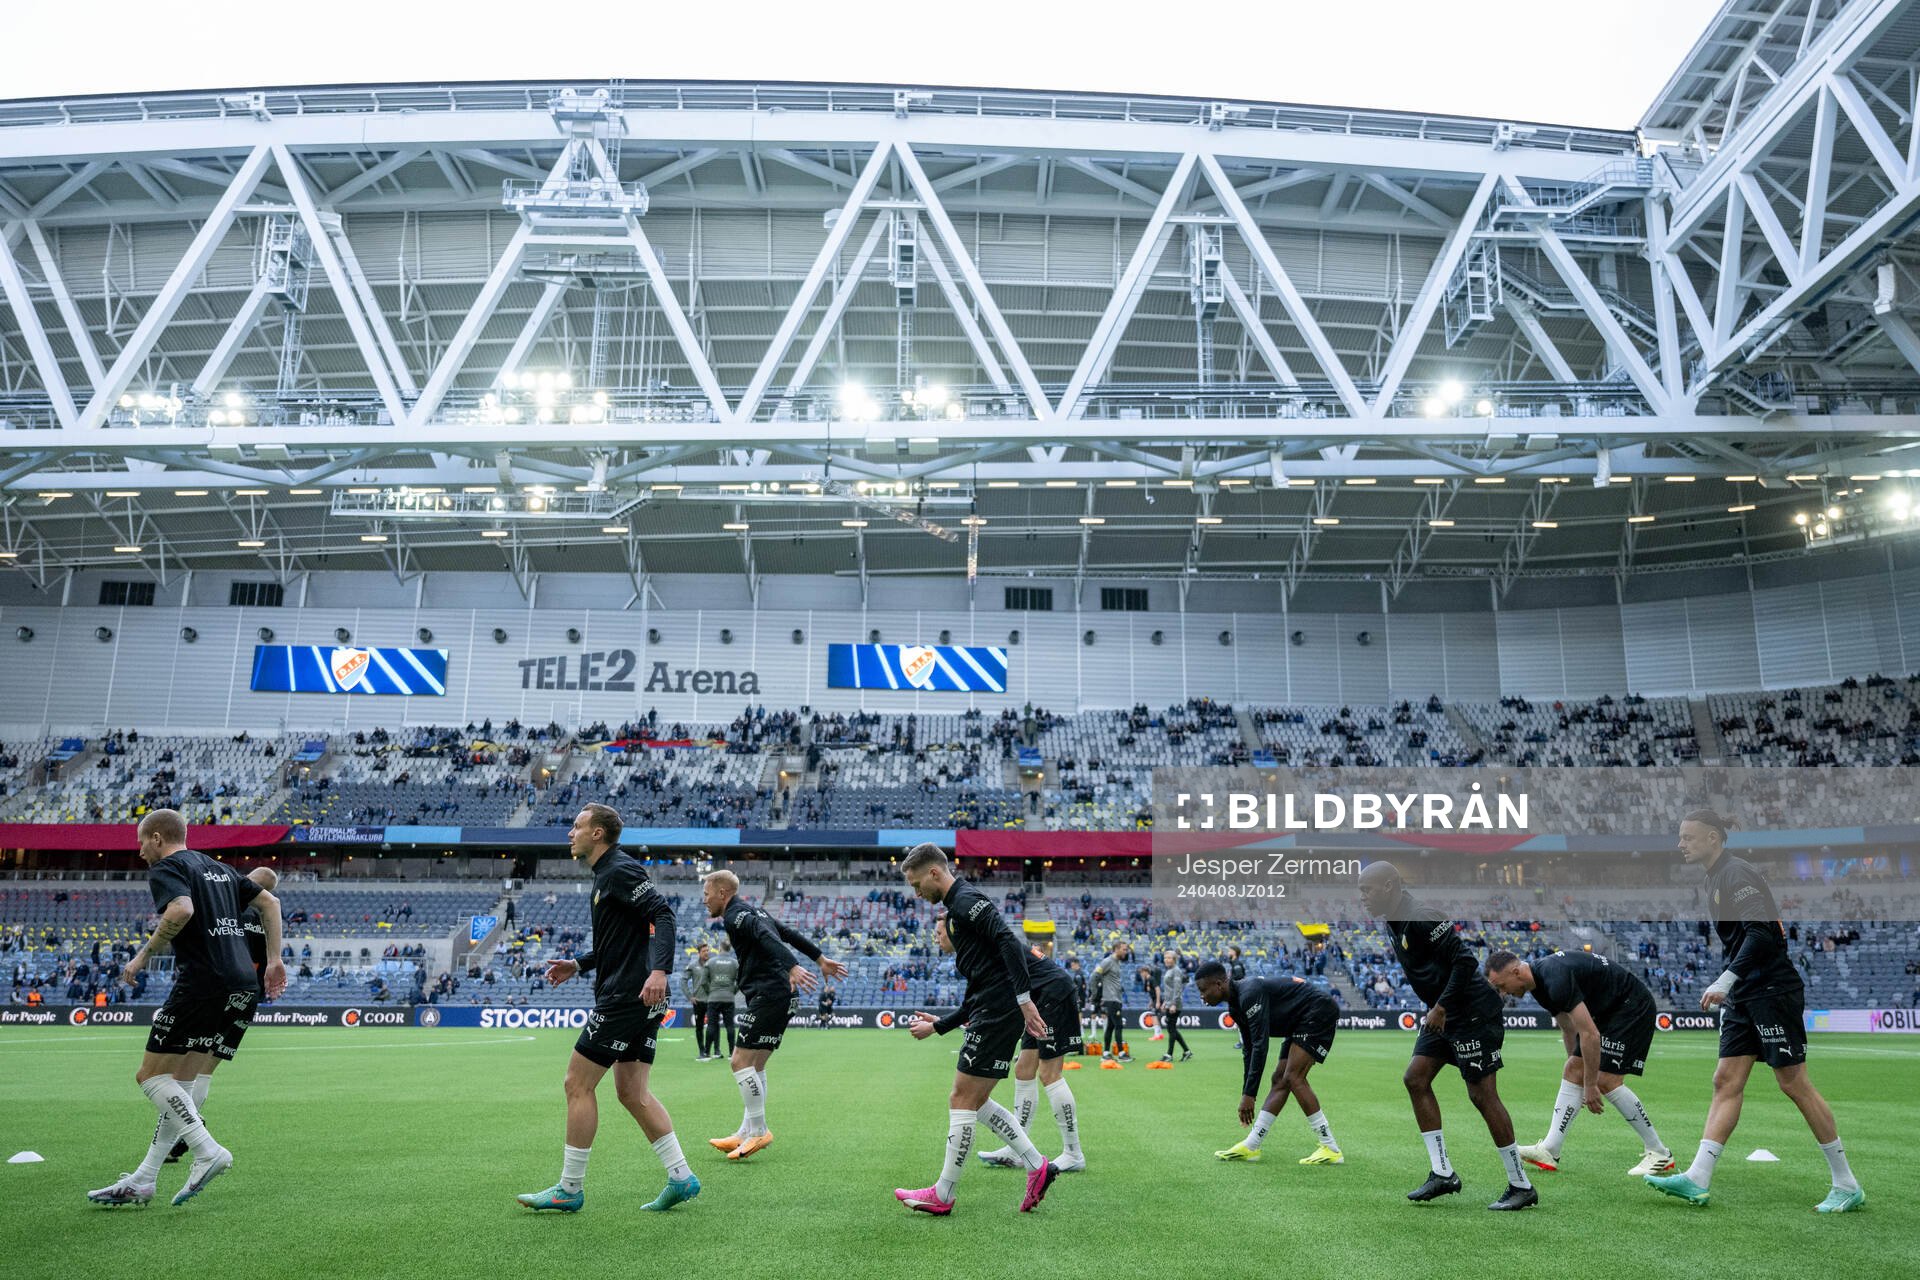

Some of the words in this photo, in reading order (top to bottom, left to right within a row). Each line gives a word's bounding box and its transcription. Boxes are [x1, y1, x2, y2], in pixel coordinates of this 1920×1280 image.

[518, 648, 636, 692] TELE2
[644, 661, 761, 695] Arena
[1, 1011, 19, 1023] for
[19, 1012, 56, 1026] People
[93, 1012, 133, 1023] COOR
[274, 1012, 291, 1023] for
[292, 1012, 328, 1026] People
[364, 1012, 405, 1024] COOR
[1351, 1016, 1386, 1030] People
[1675, 1016, 1715, 1028] COOR
[1756, 1024, 1785, 1037] Varis
[1601, 1036, 1626, 1051] Varis
[1019, 1100, 1032, 1128] MAXXIS
[1062, 1103, 1075, 1133] MAXXIS
[1559, 1106, 1575, 1134] MAXXIS
[955, 1125, 972, 1168] MAXXIS
